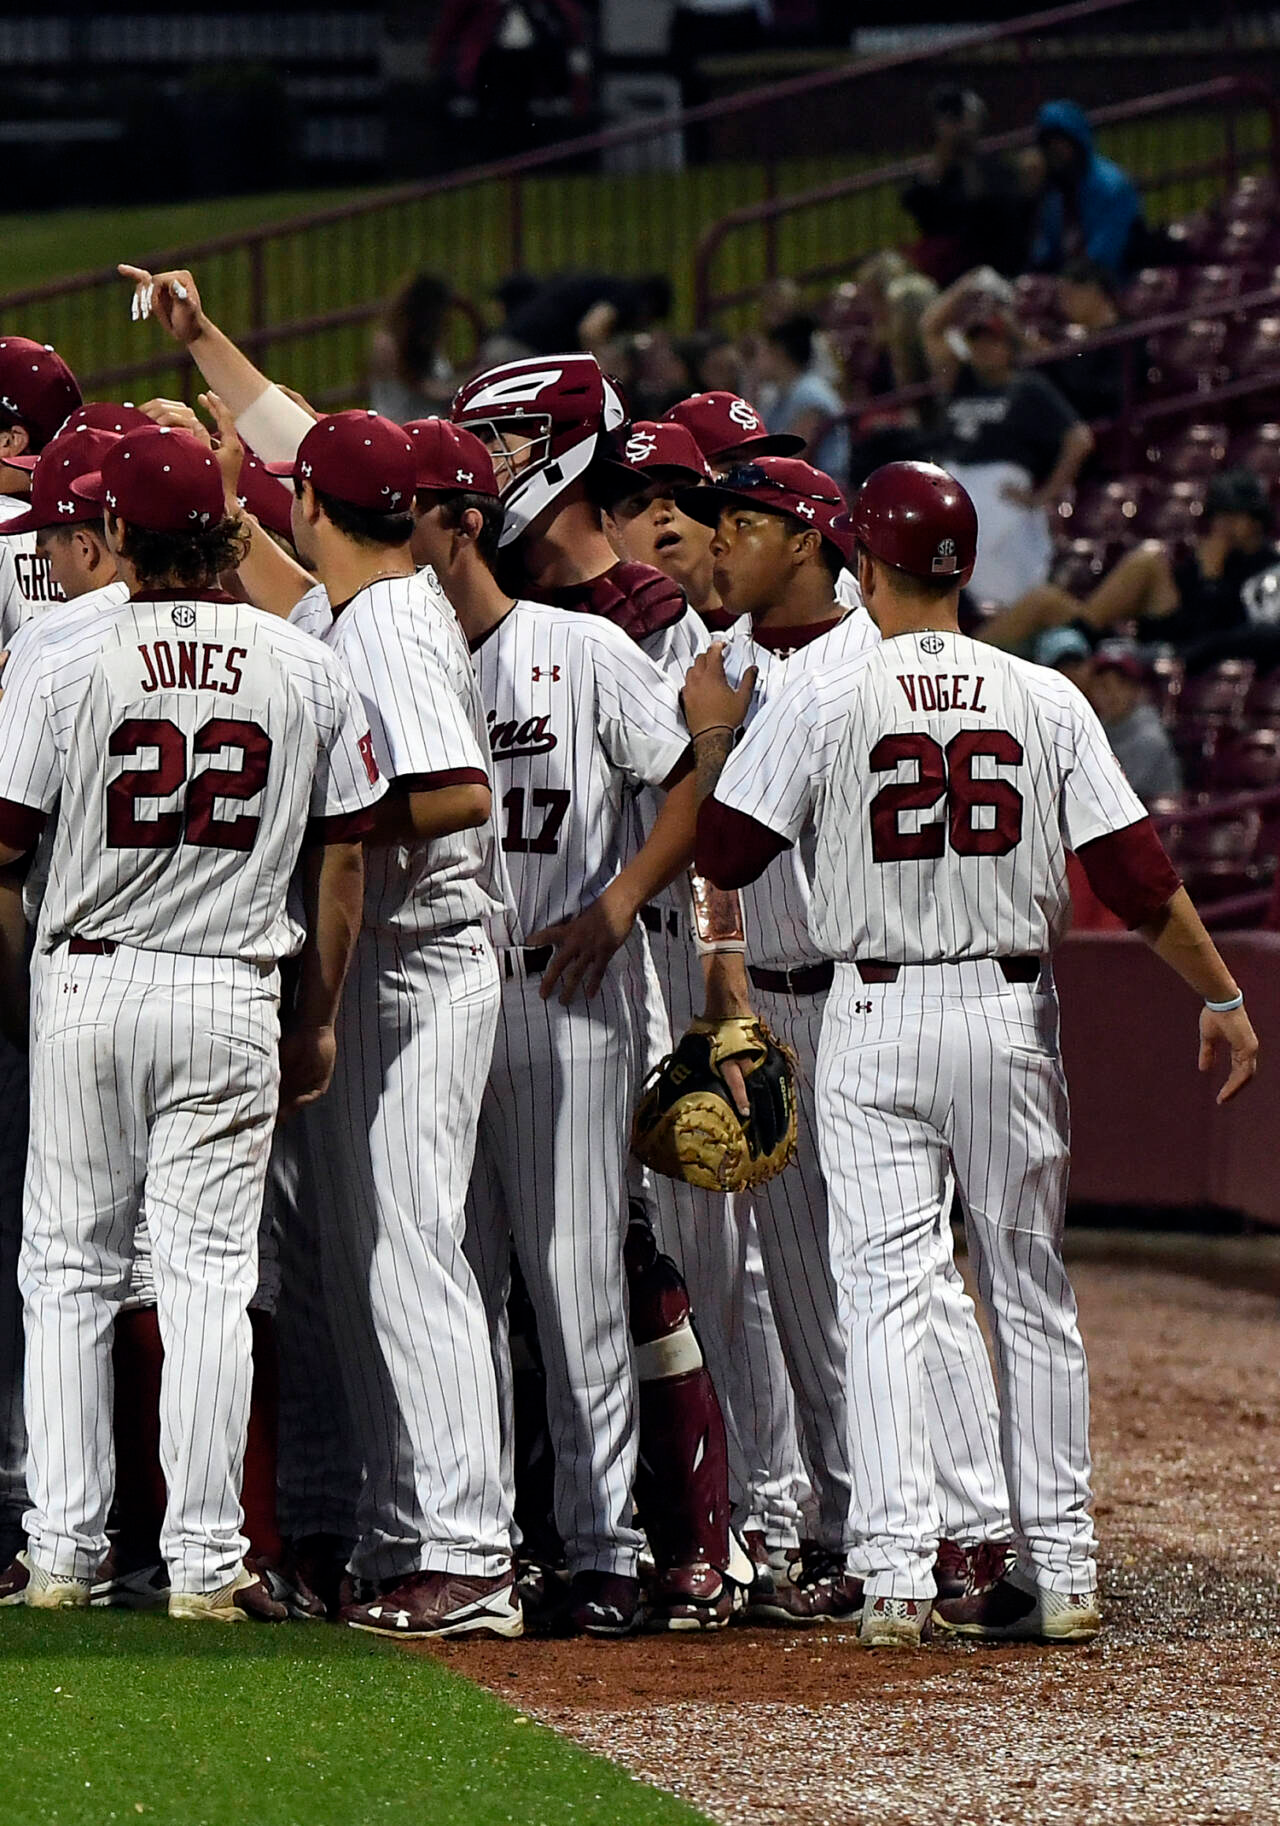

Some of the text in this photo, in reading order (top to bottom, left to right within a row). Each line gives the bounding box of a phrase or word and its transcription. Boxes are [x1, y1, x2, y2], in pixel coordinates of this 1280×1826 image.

[137, 641, 247, 695] JONES
[896, 674, 987, 714] VOGEL
[107, 717, 273, 850] 22
[869, 729, 1024, 863] 26
[502, 787, 571, 854] 17
